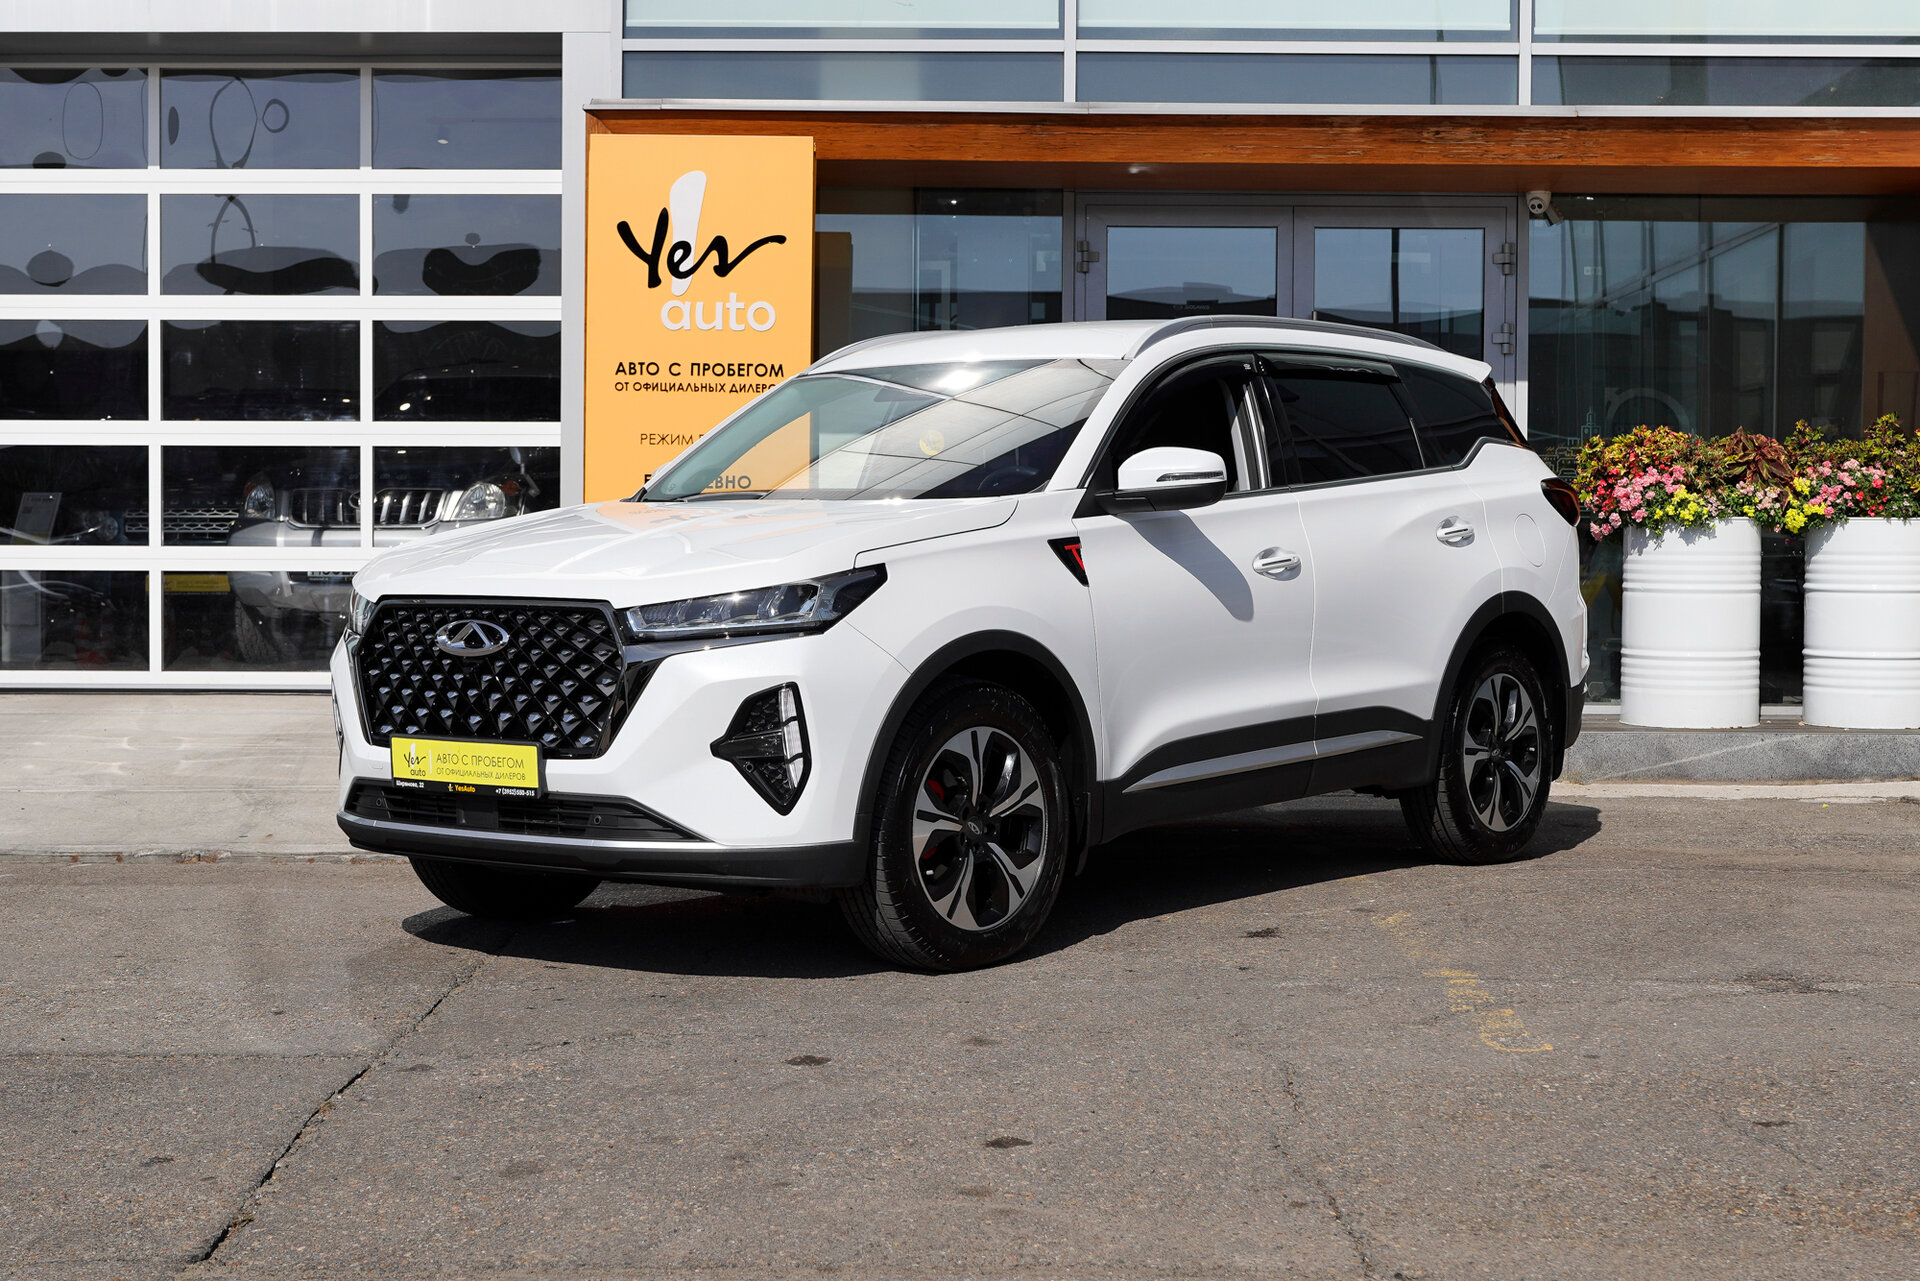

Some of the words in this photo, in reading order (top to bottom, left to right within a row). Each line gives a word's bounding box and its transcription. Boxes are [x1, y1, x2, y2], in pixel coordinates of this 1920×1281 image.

[616, 207, 787, 289] Yes
[660, 292, 776, 331] auto
[615, 361, 660, 377] АВТО
[668, 362, 681, 377] С
[690, 362, 784, 378] ПРОБЕГОМ
[614, 381, 629, 392] ОТ
[632, 381, 726, 393] ОФИЦИАЛЬНЫХ
[729, 383, 776, 393] ДИЛЕР
[640, 433, 694, 446] РЕЖИМ
[403, 751, 426, 768] Yes
[436, 753, 459, 765] АВТО
[461, 754, 469, 766] С
[471, 755, 525, 769] ПРОБЕГОМ
[410, 768, 426, 777] auto
[436, 767, 445, 775] ОТ
[445, 768, 494, 779] ОФИЦИАЛЬНЫХ
[495, 772, 526, 781] ДИЛЕРОВ
